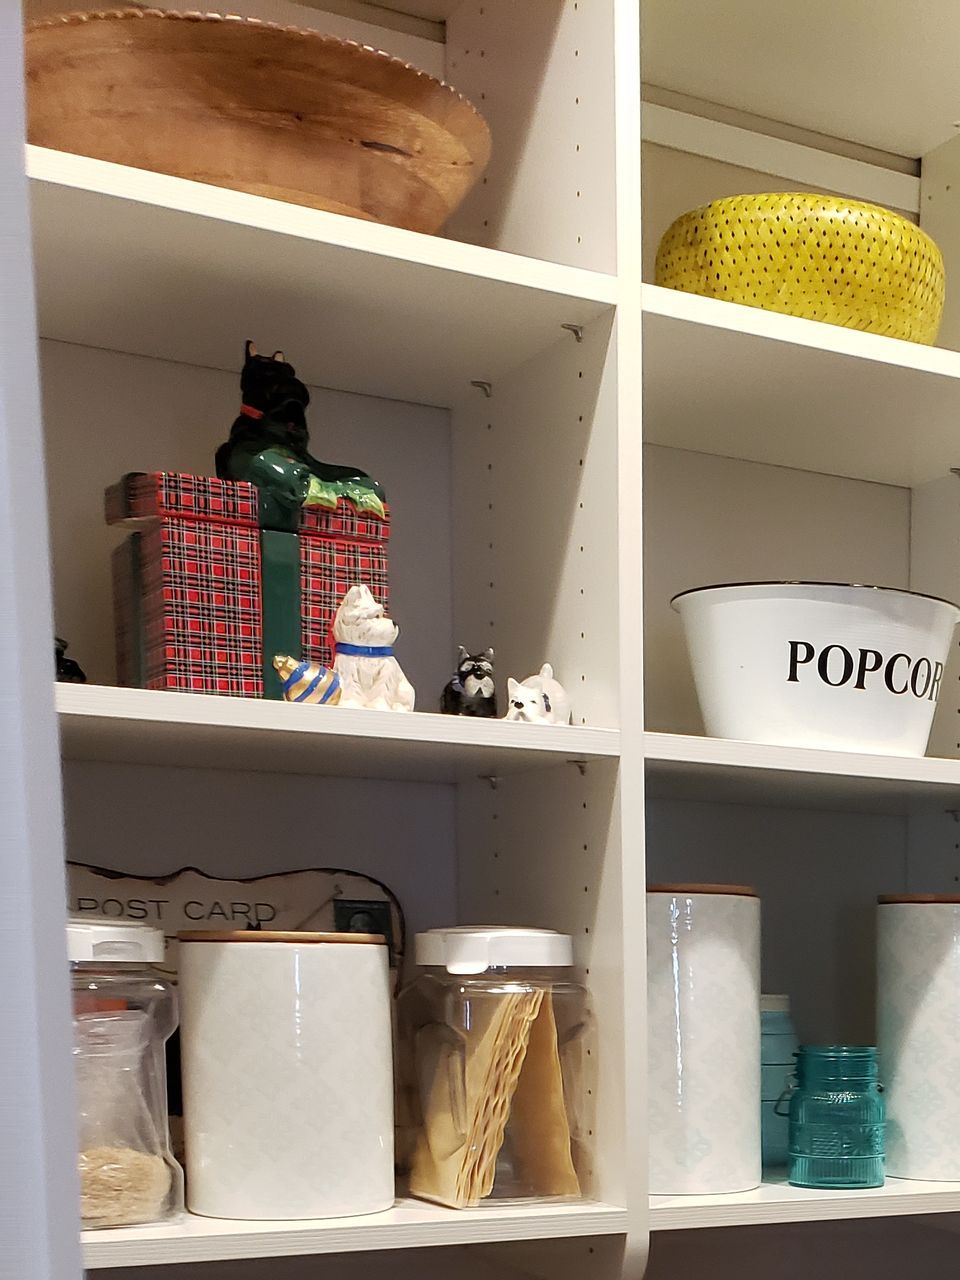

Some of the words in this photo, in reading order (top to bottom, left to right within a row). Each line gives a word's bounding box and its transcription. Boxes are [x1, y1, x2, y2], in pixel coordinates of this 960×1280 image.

[786, 640, 944, 702] POPCOR
[76, 897, 169, 920] POST
[184, 901, 276, 922] CARD
